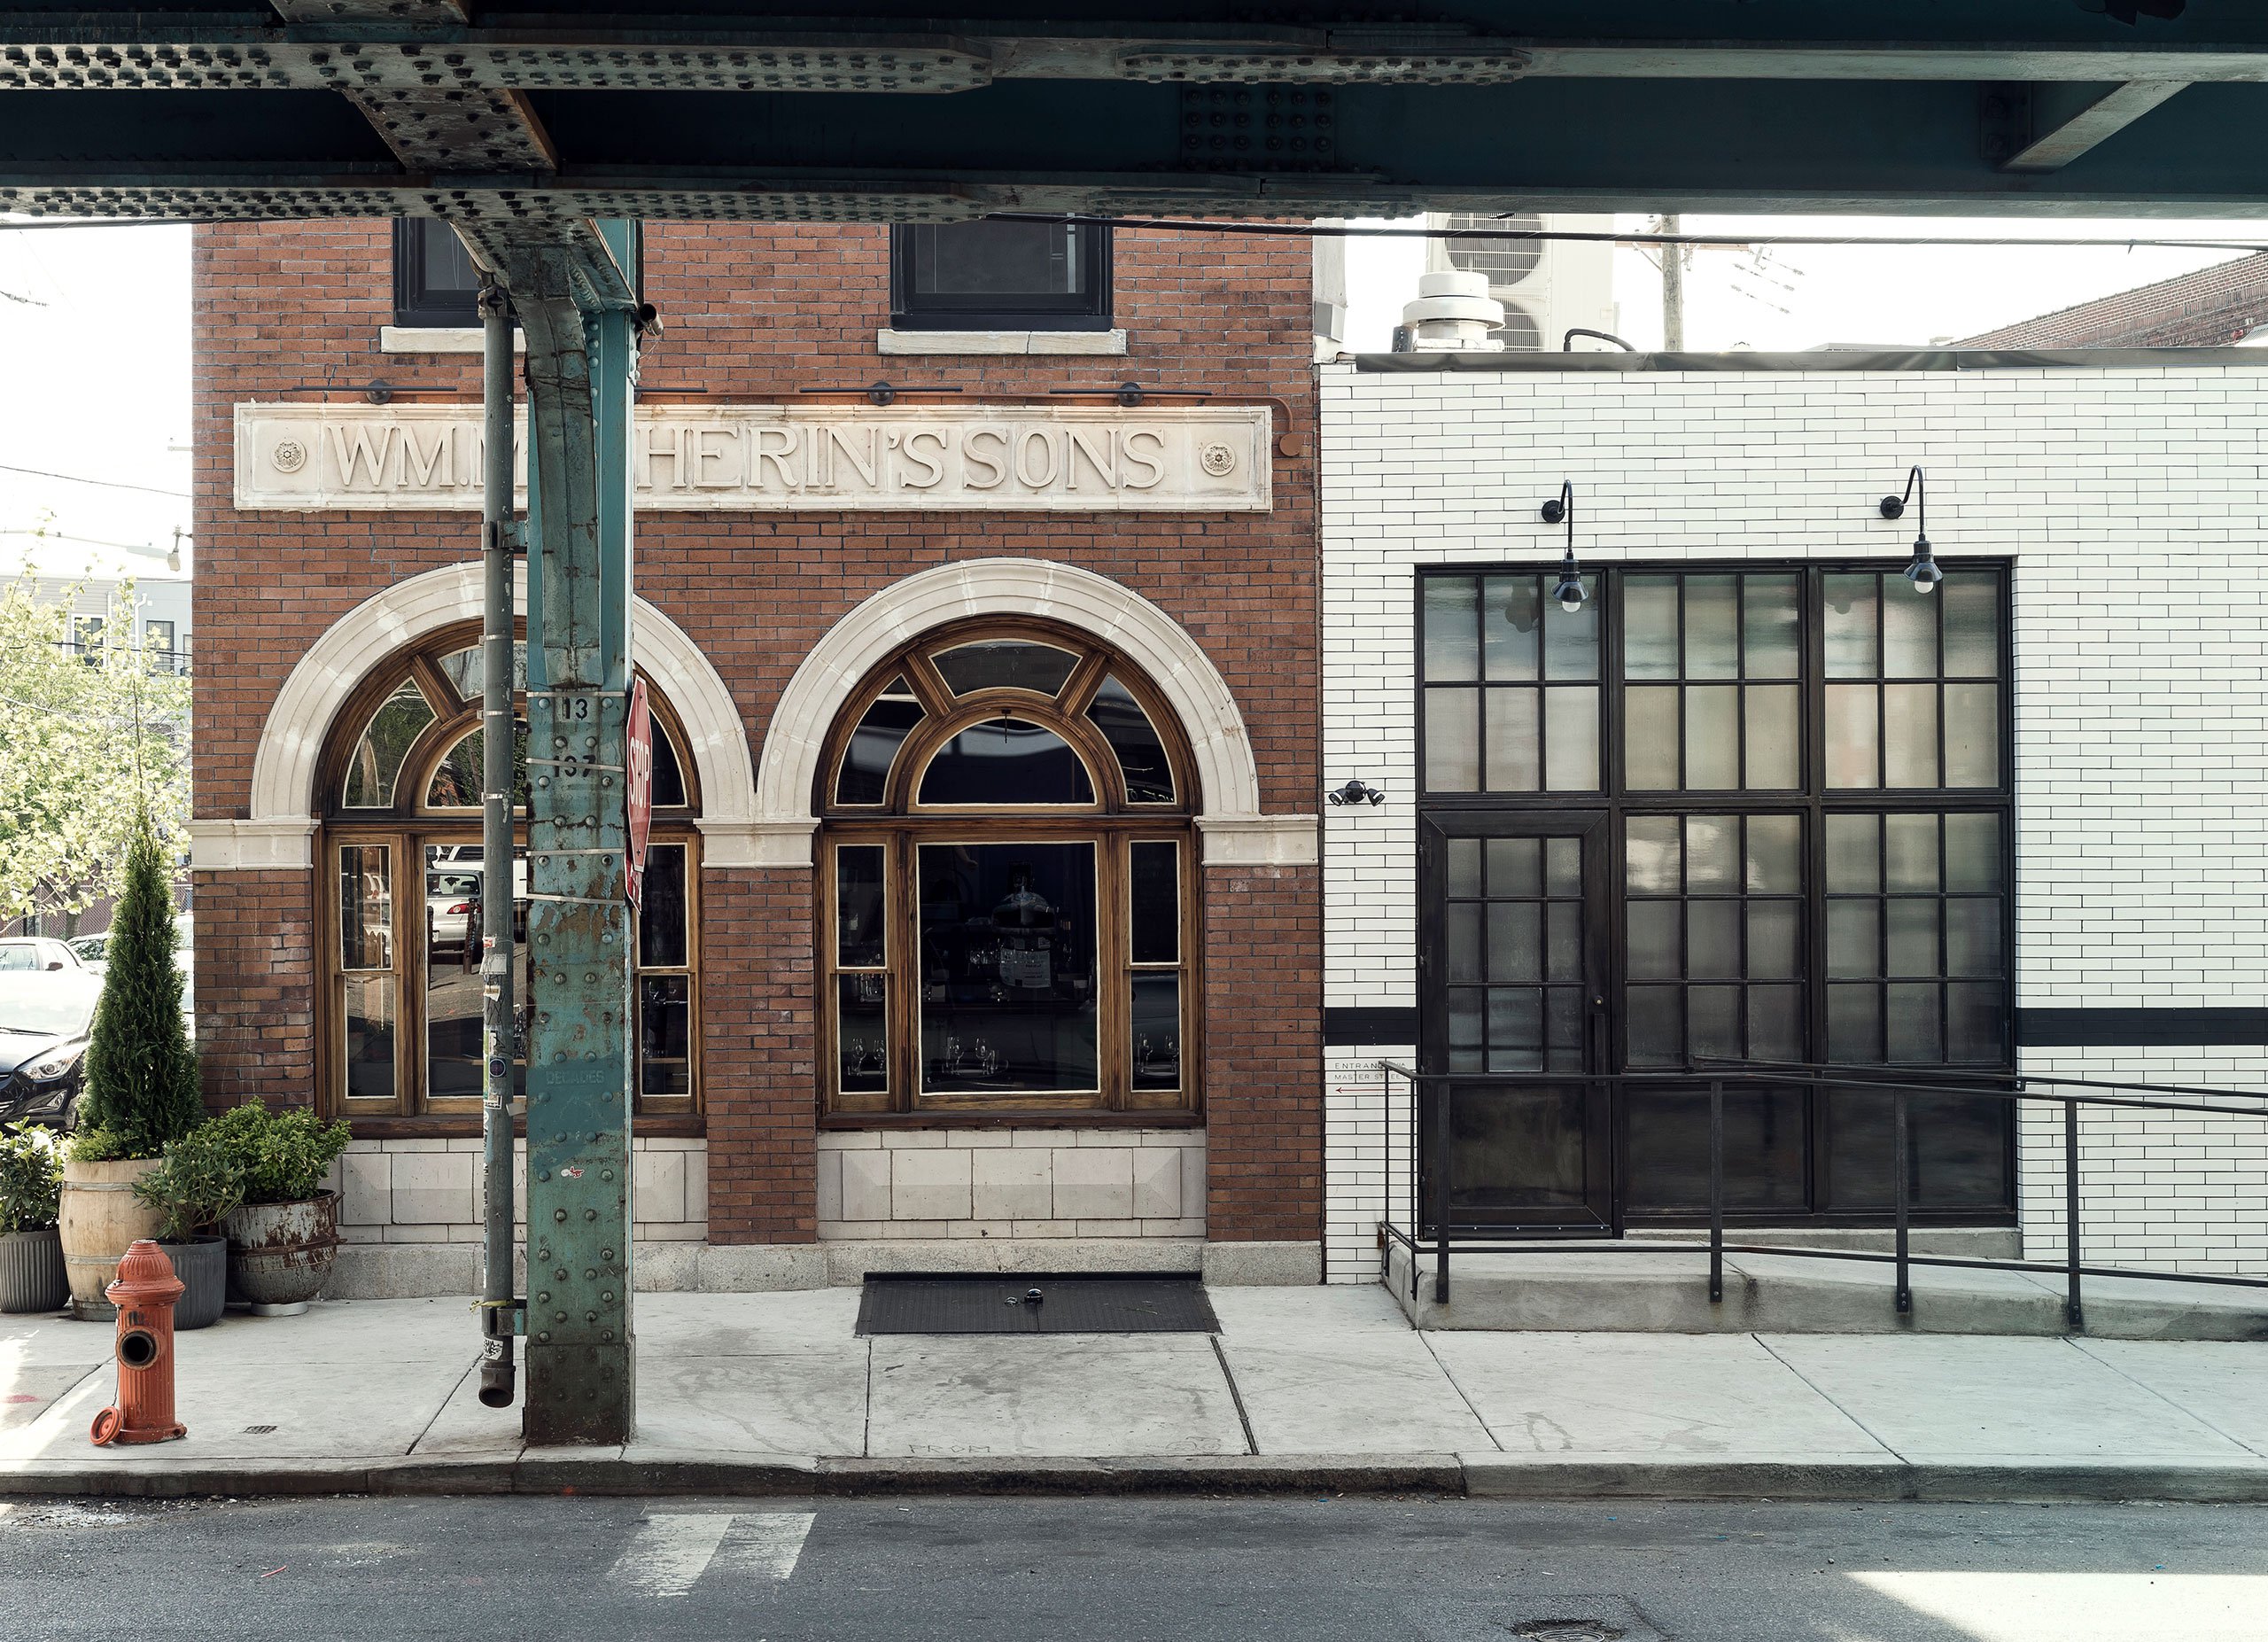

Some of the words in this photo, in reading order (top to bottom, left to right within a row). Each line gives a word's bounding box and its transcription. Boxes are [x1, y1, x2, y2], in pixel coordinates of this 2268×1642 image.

[327, 424, 469, 488] WM.
[474, 424, 947, 490] MHERIN'S
[963, 426, 1165, 489] SONS
[563, 696, 588, 720] 13
[630, 735, 650, 809] STOP
